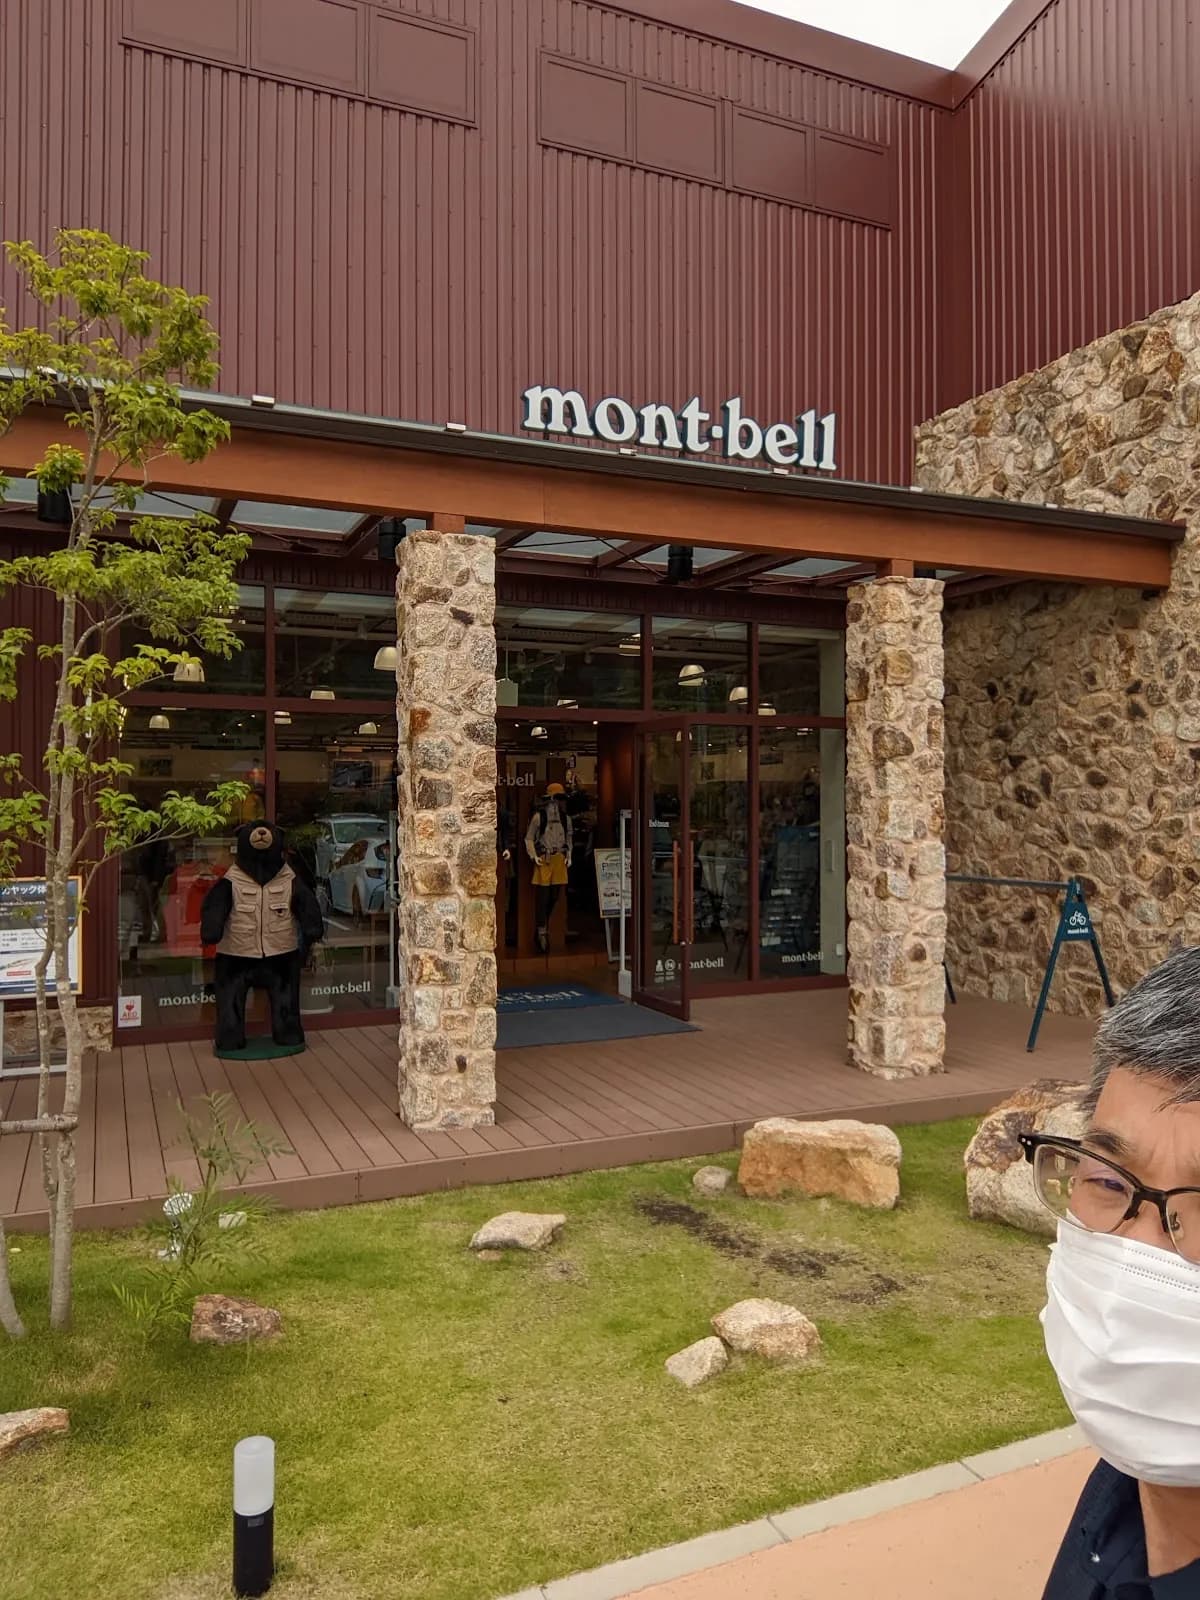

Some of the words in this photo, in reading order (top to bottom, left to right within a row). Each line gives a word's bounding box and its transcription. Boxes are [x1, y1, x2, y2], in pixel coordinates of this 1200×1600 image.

[522, 384, 837, 471] mont·bell
[497, 773, 535, 786] t·bell
[678, 956, 724, 970] nt·bell
[311, 980, 371, 995] mont·bell
[159, 991, 216, 1006] mont·be
